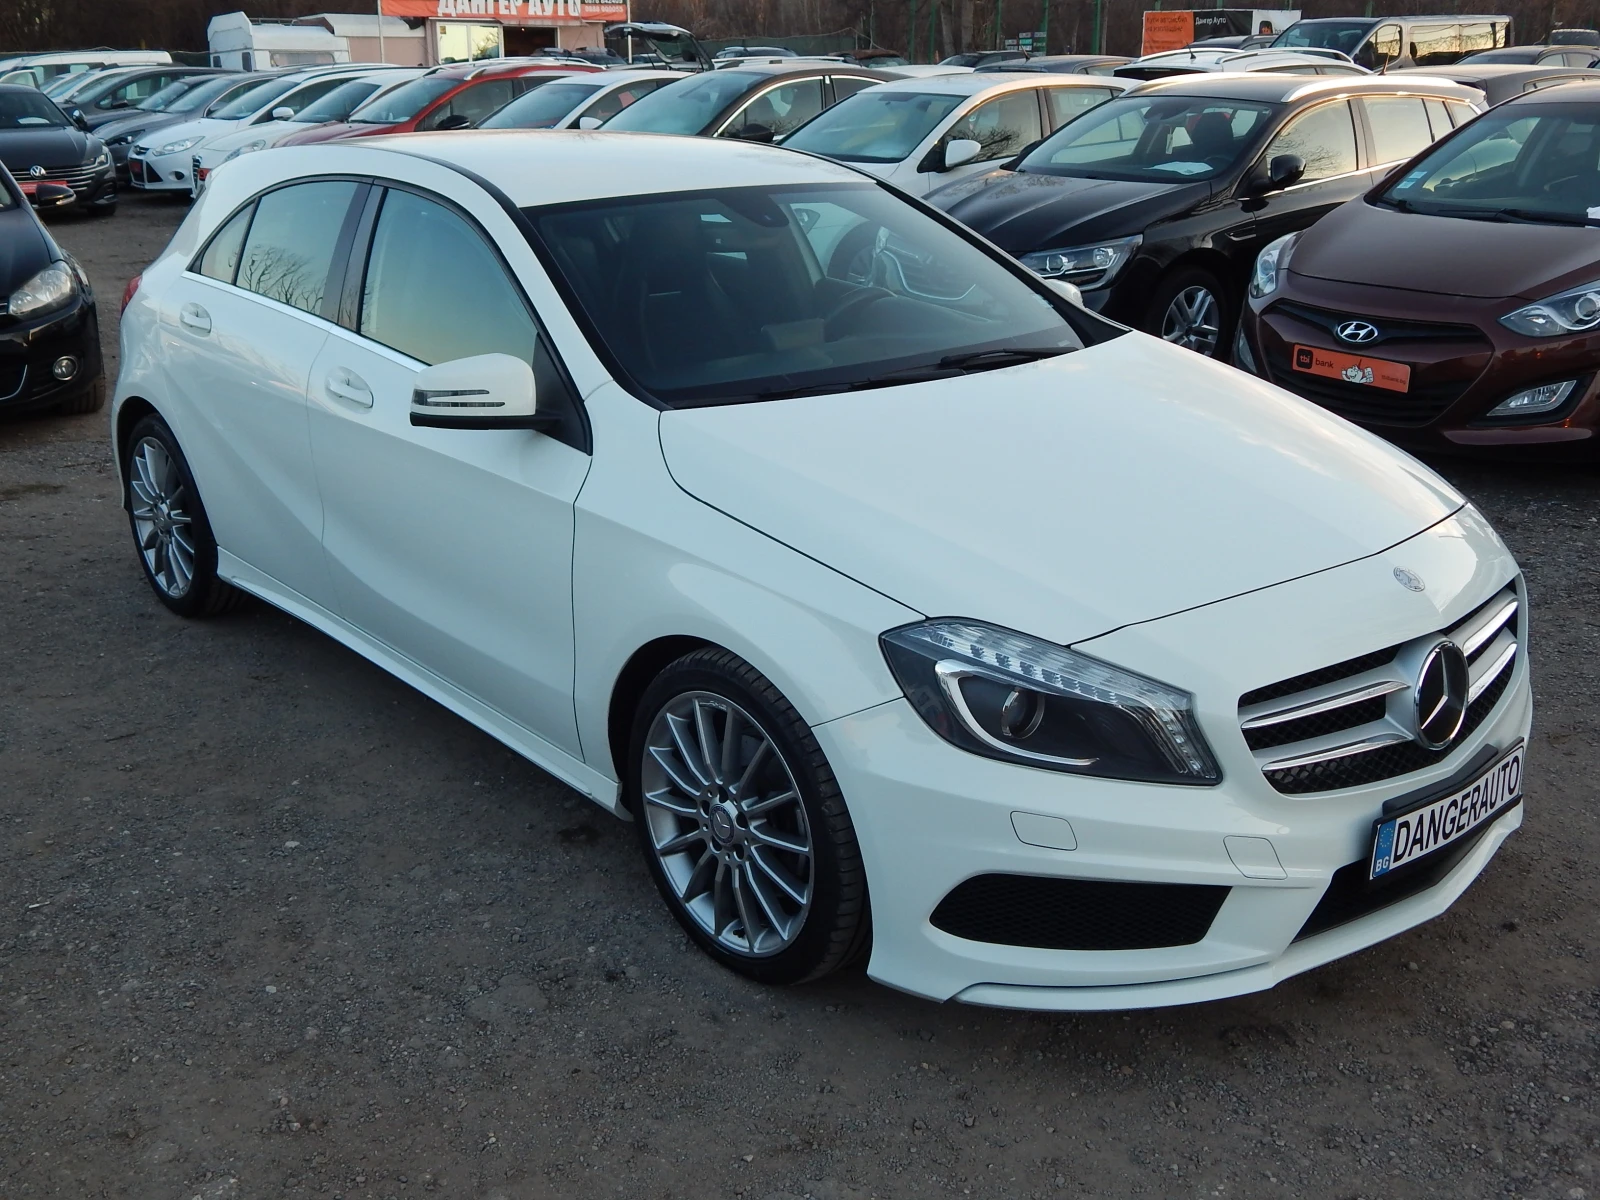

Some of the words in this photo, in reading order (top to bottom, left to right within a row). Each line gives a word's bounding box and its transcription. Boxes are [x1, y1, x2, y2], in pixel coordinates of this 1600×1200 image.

[1315, 358, 1334, 368] bank
[1392, 755, 1520, 864] DANGERAUTO
[1375, 856, 1390, 873] BG
